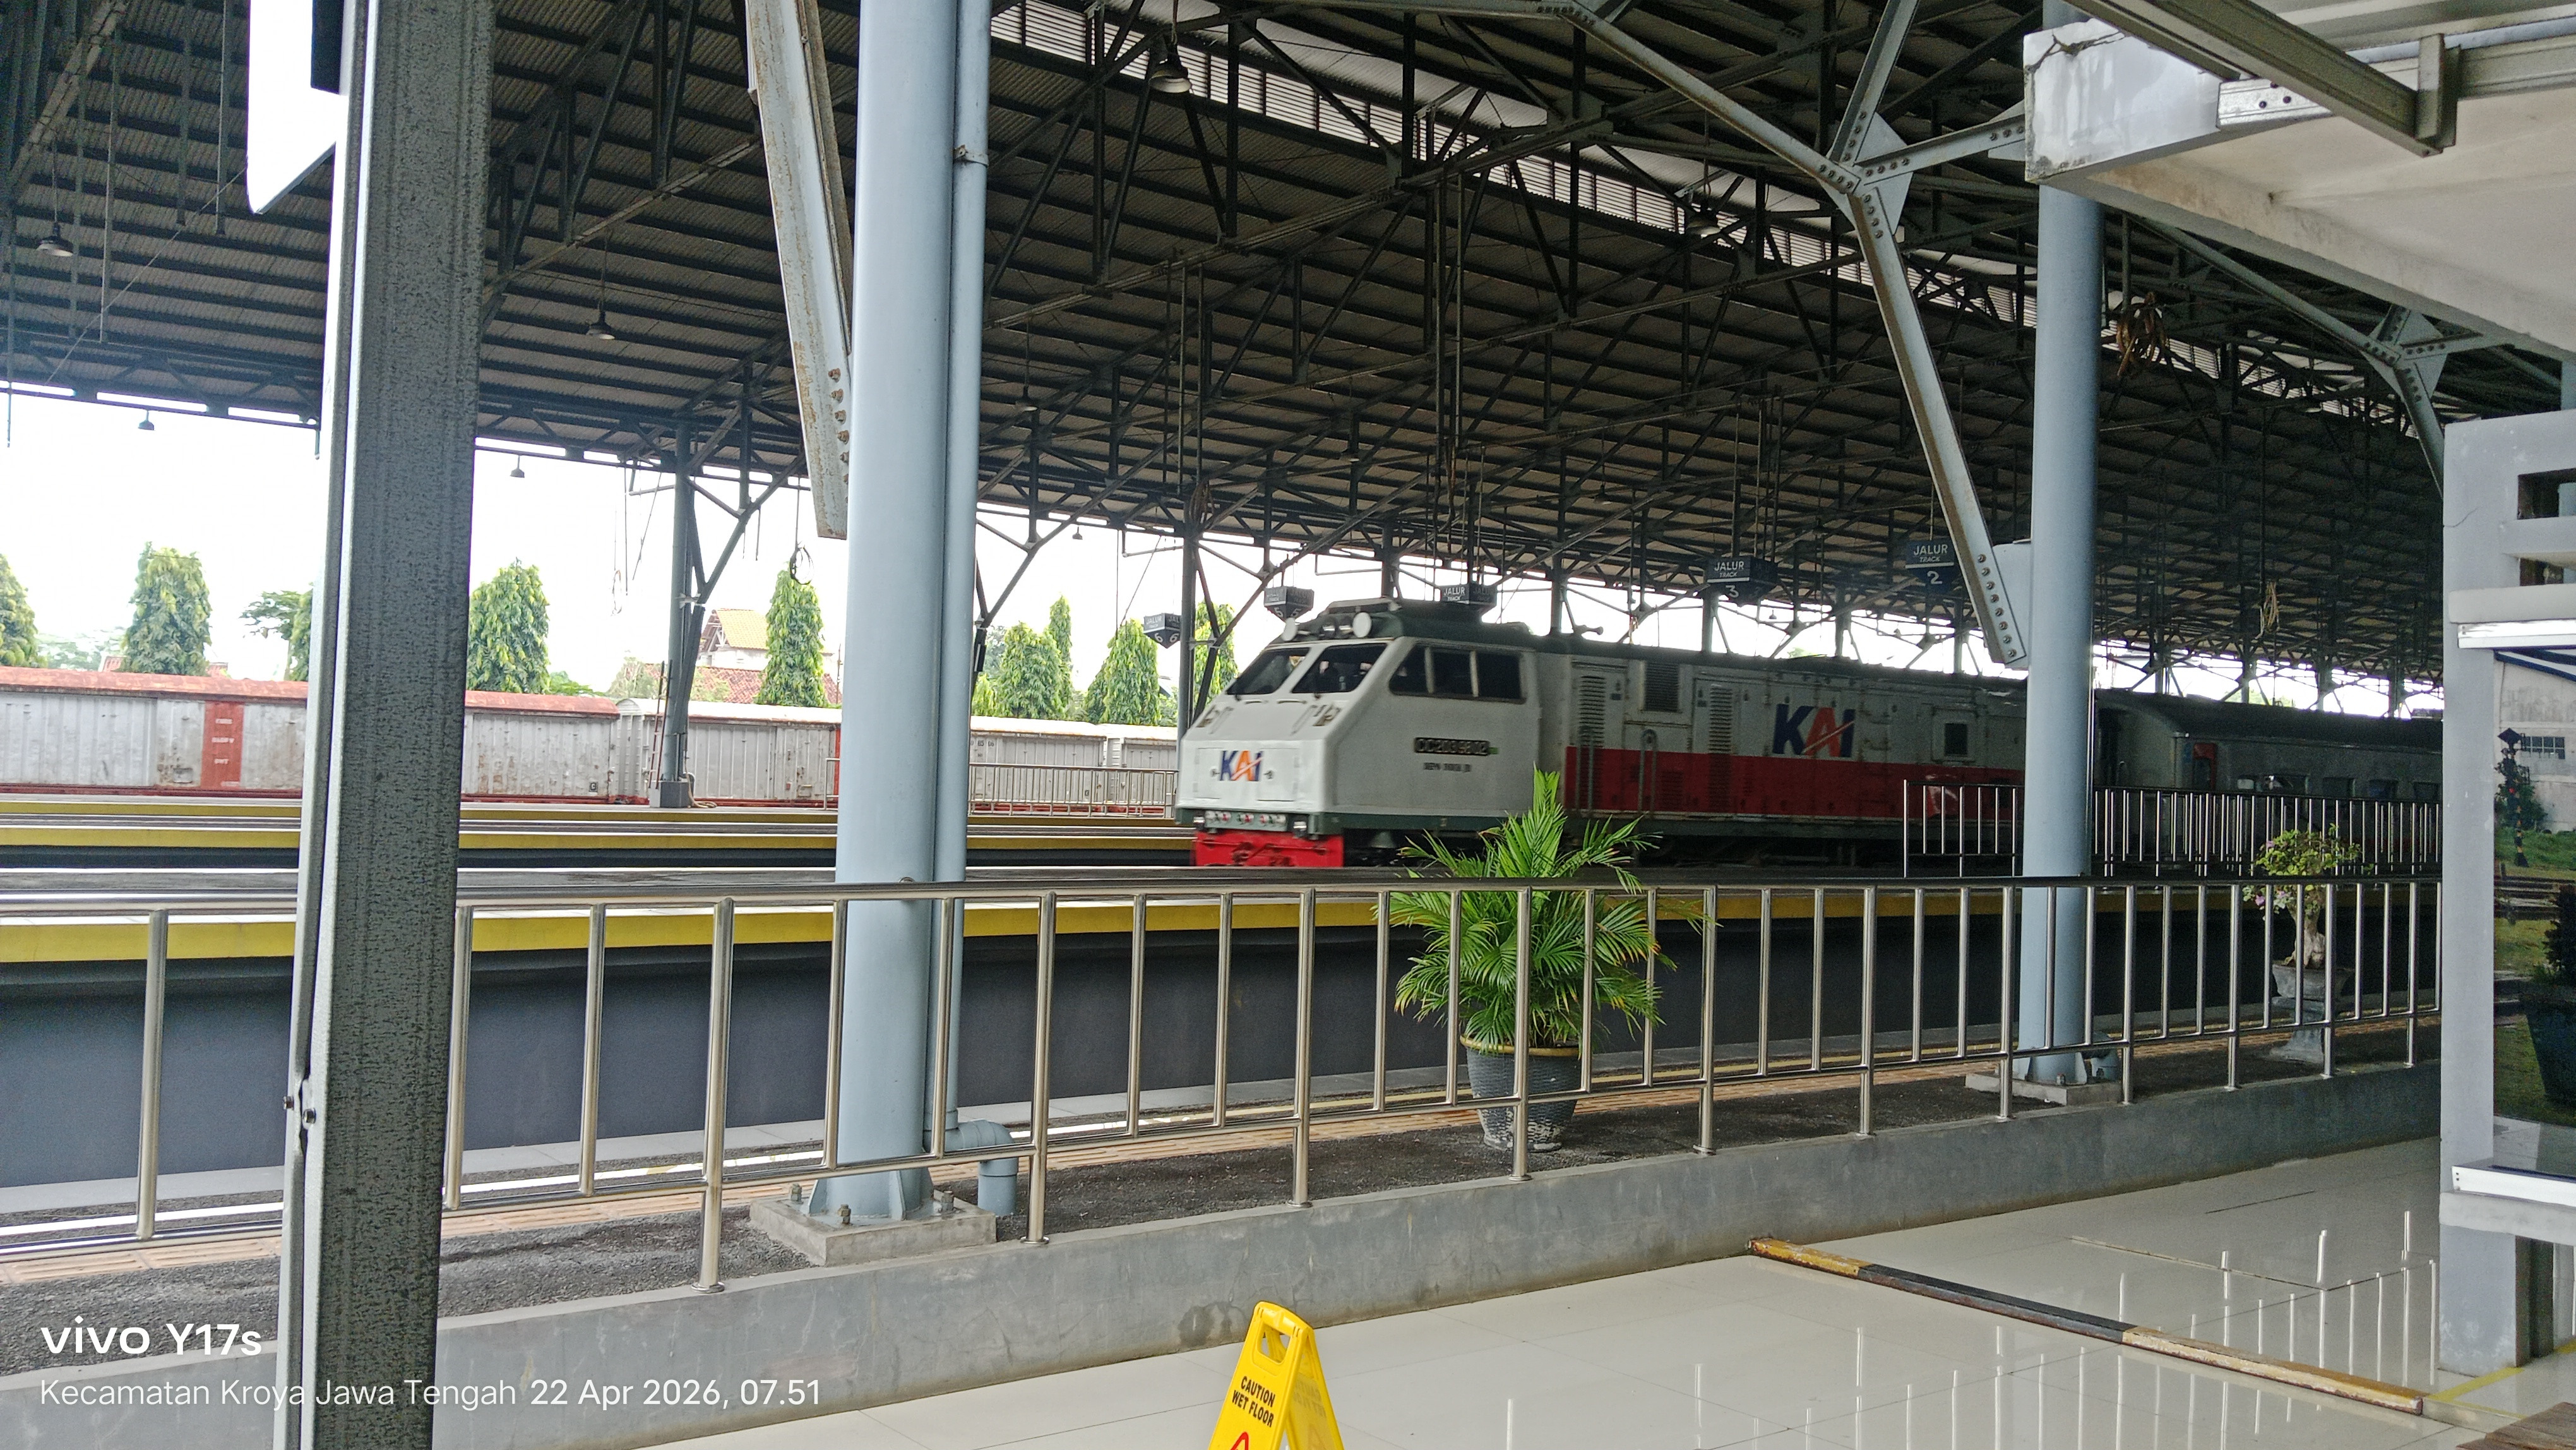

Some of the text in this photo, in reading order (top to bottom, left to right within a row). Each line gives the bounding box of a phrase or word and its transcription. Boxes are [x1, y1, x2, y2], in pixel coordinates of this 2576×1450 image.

[1914, 544, 1948, 556] JALUR
[1714, 561, 1744, 572] JALUR
[1927, 570, 1943, 584] 2
[1443, 587, 1465, 596] JALUR
[1726, 585, 1739, 598] 3
[1274, 607, 1284, 618] 5
[1290, 608, 1301, 618] 5
[1147, 616, 1162, 625] JALUR
[1154, 632, 1163, 643] 6
[1169, 633, 1179, 643] 6
[1772, 704, 1856, 757] KAI
[1219, 750, 1263, 781] KAI
[1241, 1375, 1276, 1408] CAUTION
[1232, 1389, 1274, 1427] WET FLOOR
